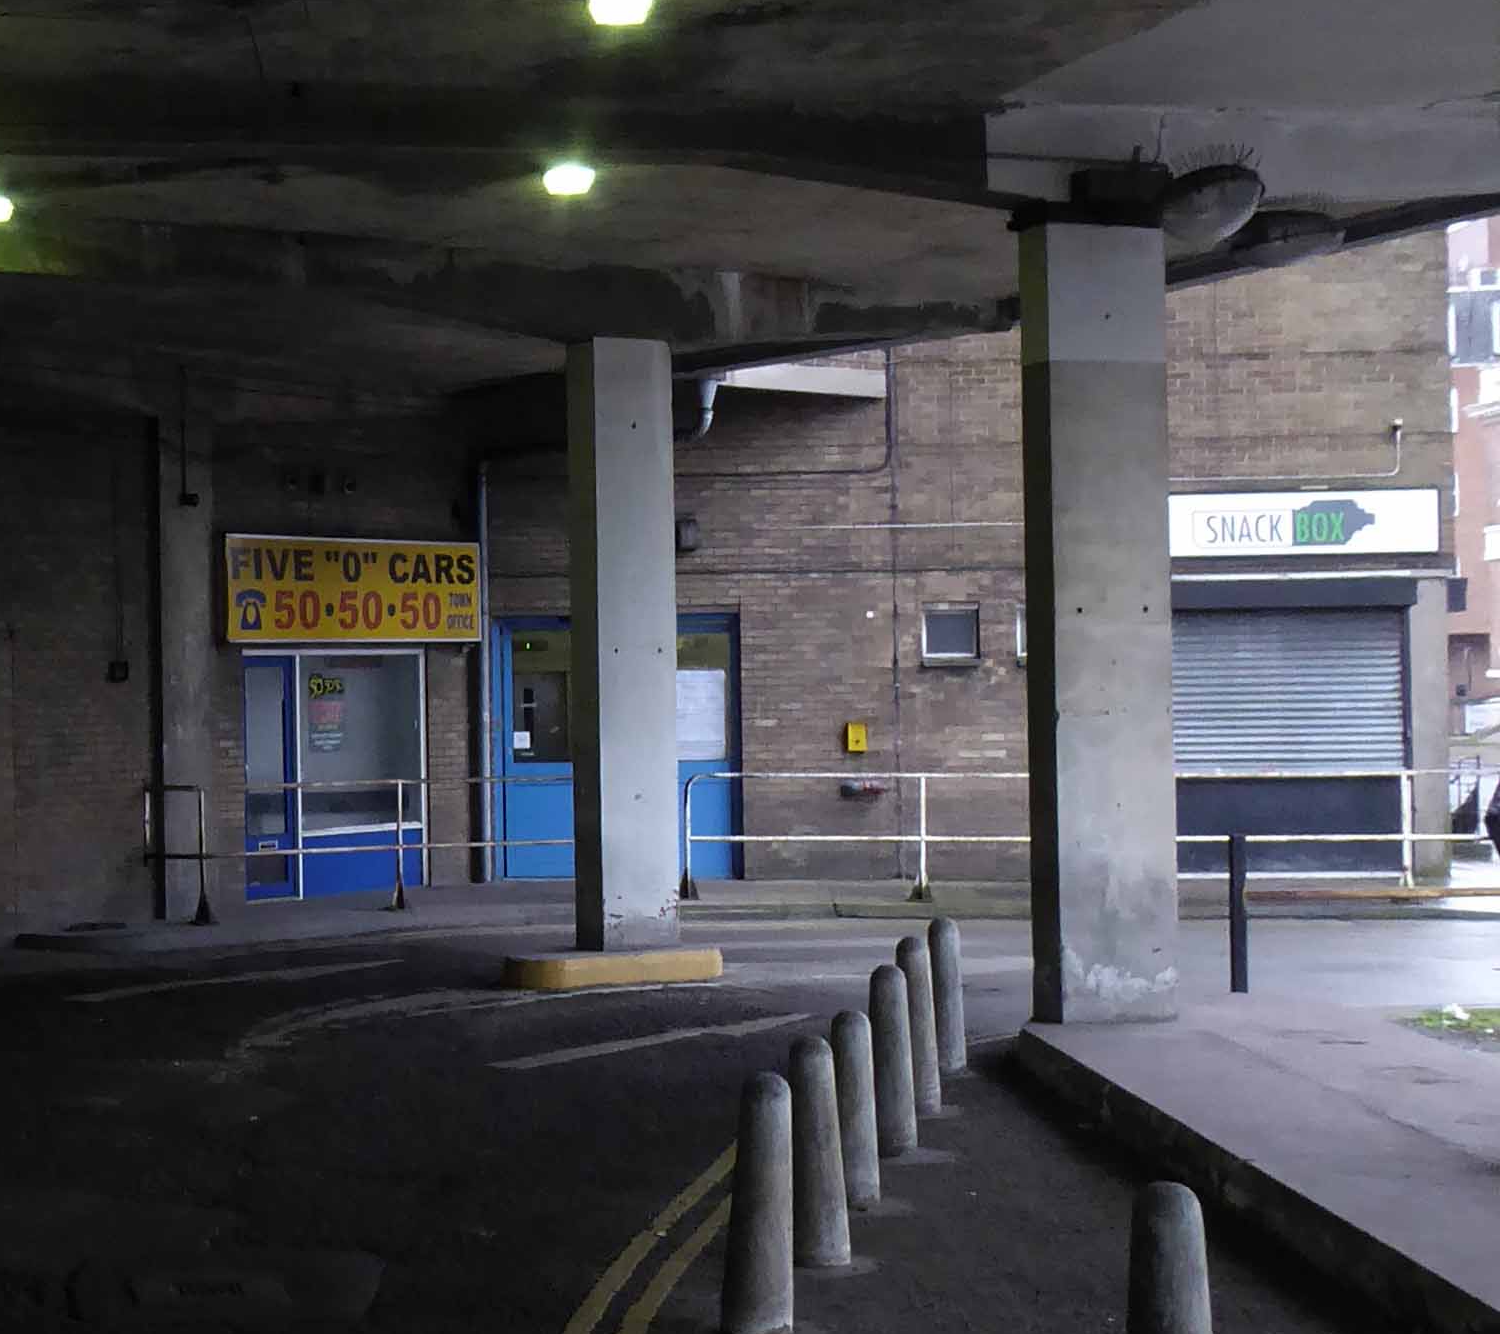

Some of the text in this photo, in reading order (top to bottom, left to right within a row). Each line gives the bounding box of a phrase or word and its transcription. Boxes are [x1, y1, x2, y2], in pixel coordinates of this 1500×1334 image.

[1206, 511, 1345, 543] SNACK BOX
[230, 547, 315, 581] FIVE
[388, 553, 476, 584] CARS
